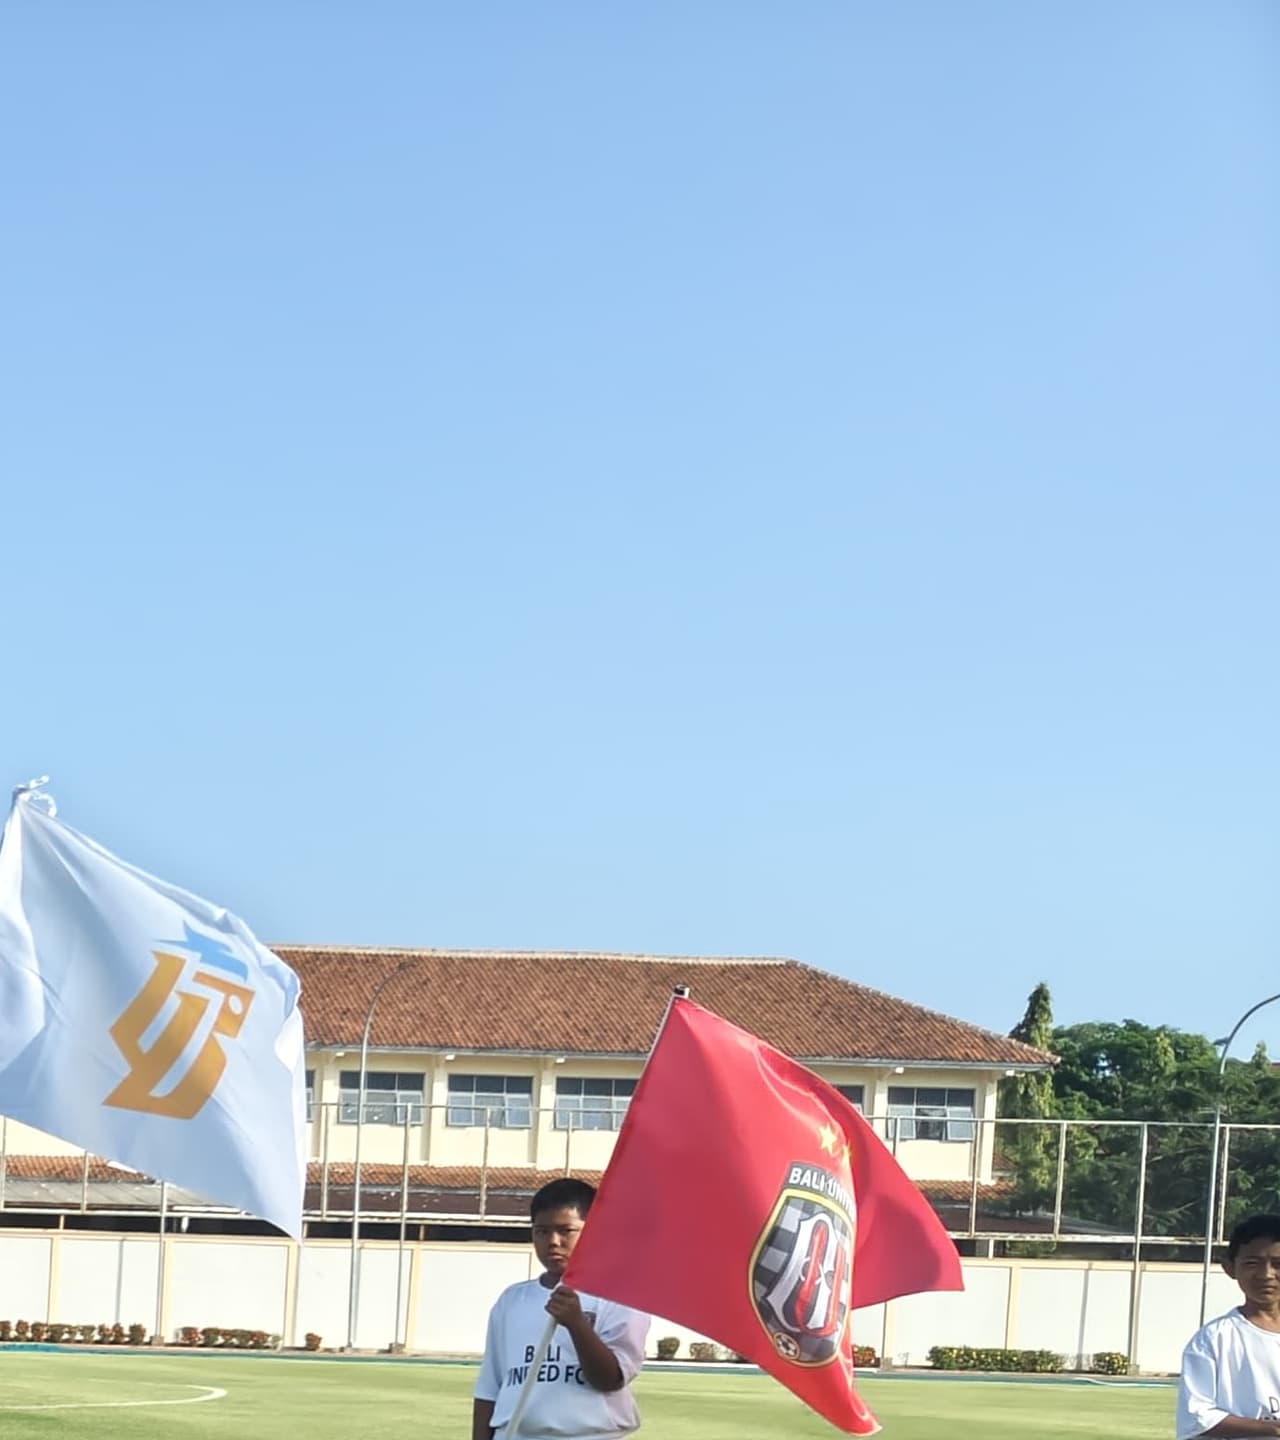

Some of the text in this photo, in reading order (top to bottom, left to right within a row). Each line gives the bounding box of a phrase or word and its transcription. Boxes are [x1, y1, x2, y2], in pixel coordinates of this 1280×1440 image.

[788, 1167, 825, 1192] BALI
[525, 1344, 561, 1363] BLI
[507, 1365, 560, 1387] NIED
